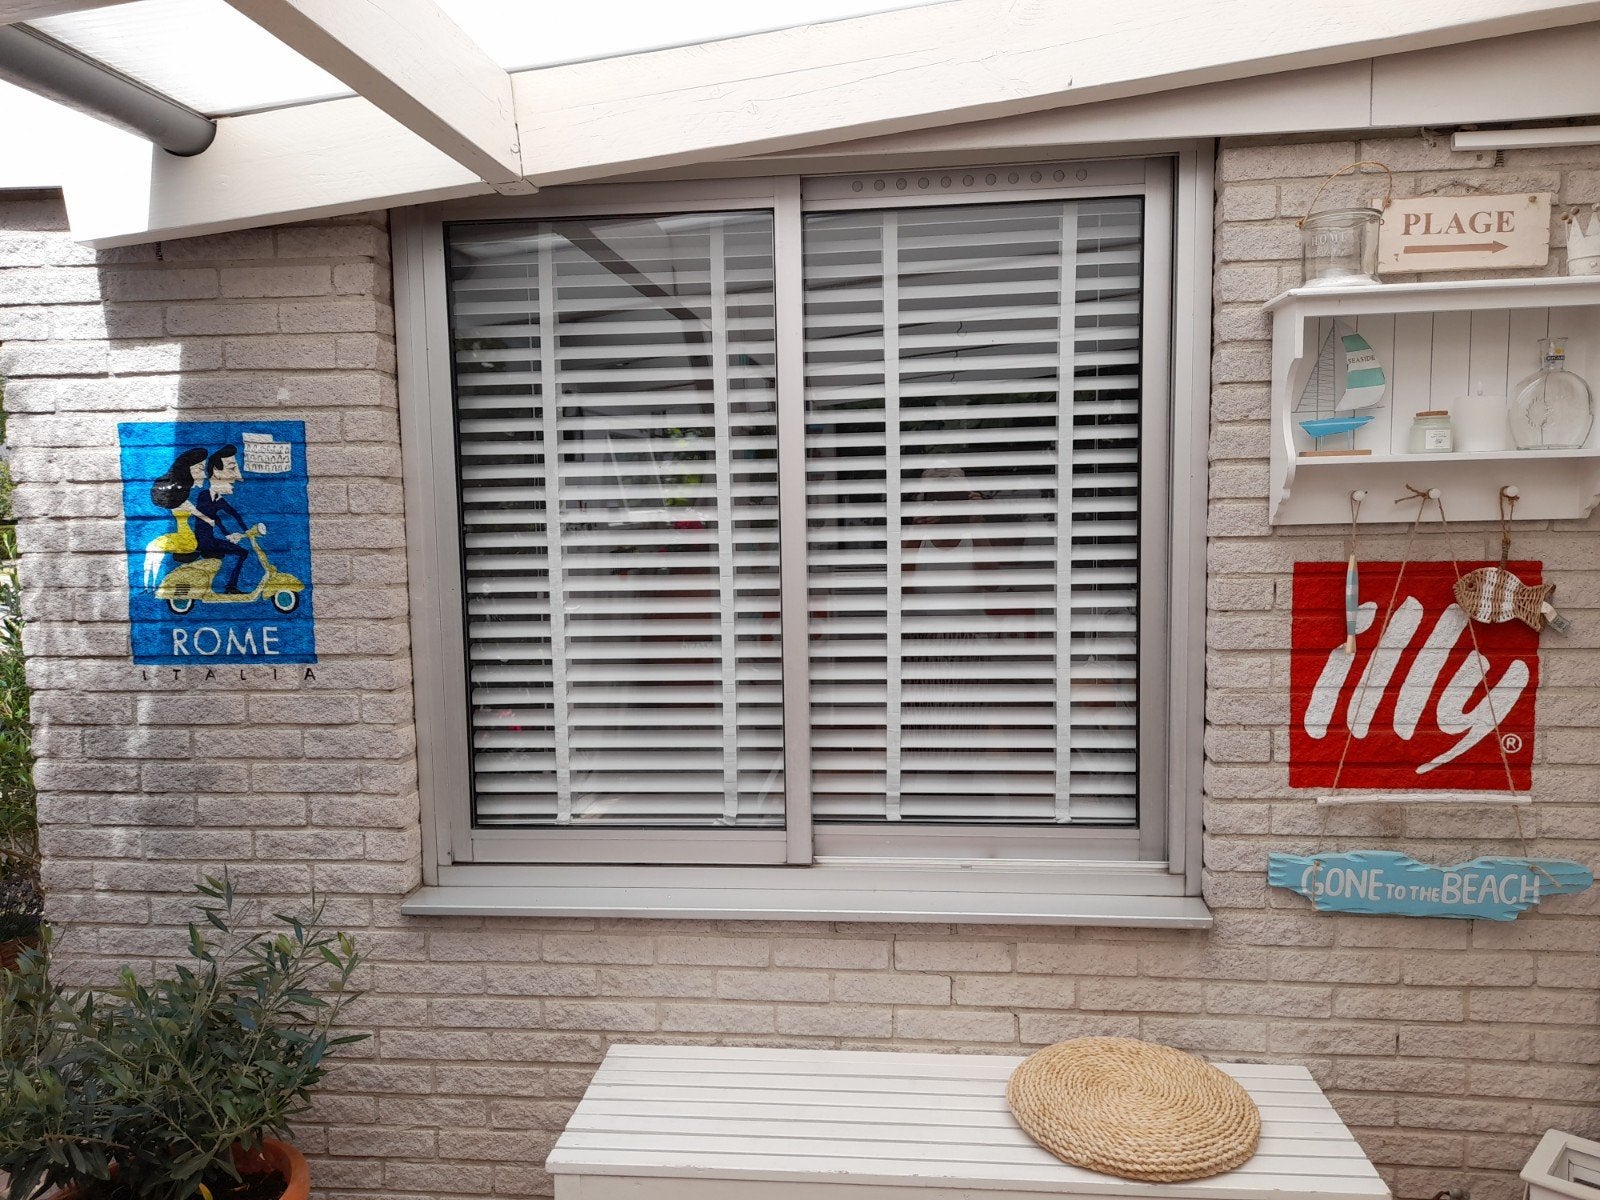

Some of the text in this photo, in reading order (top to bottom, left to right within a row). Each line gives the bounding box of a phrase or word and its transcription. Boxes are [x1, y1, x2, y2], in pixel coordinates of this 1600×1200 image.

[1401, 210, 1516, 236] PLAGE
[1347, 355, 1376, 365] SEASIDE
[172, 626, 280, 656] ROME
[142, 668, 316, 681] ITALIA
[1303, 595, 1530, 775] illy
[1301, 865, 1541, 905] GONE TO THE BEACH
